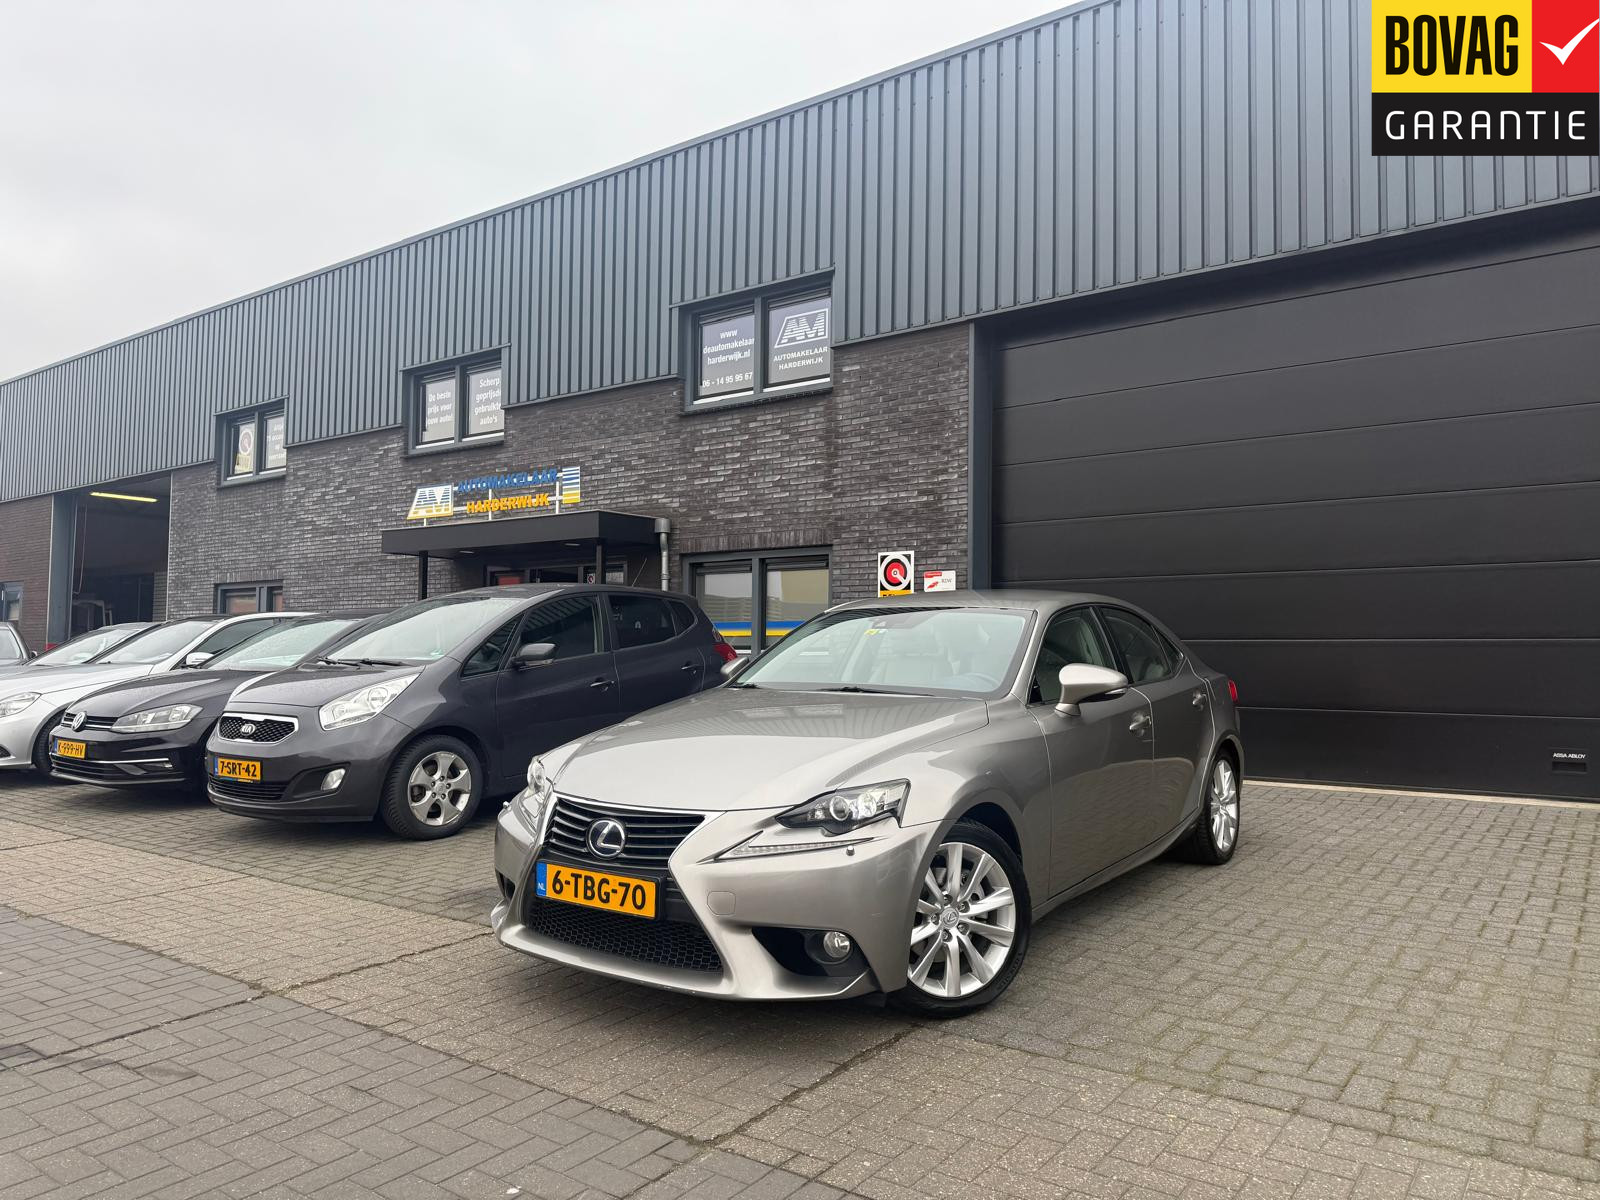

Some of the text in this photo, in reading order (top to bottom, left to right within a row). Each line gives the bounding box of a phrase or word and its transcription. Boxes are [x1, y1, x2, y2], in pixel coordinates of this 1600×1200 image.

[719, 329, 738, 340] www
[707, 349, 751, 366] harderwijk.nl
[773, 347, 828, 362] AUTOMAKELAAR
[778, 357, 824, 370] HARDERWIJK
[479, 377, 500, 388] Scherp
[475, 389, 502, 403] geprijsd
[479, 414, 498, 425] auto's
[457, 469, 557, 493] AUTOMAKELAAR
[466, 493, 550, 513] HARDERWIJK
[219, 760, 257, 777] 7-SRT-42
[552, 869, 647, 911] 6-TBG-70
